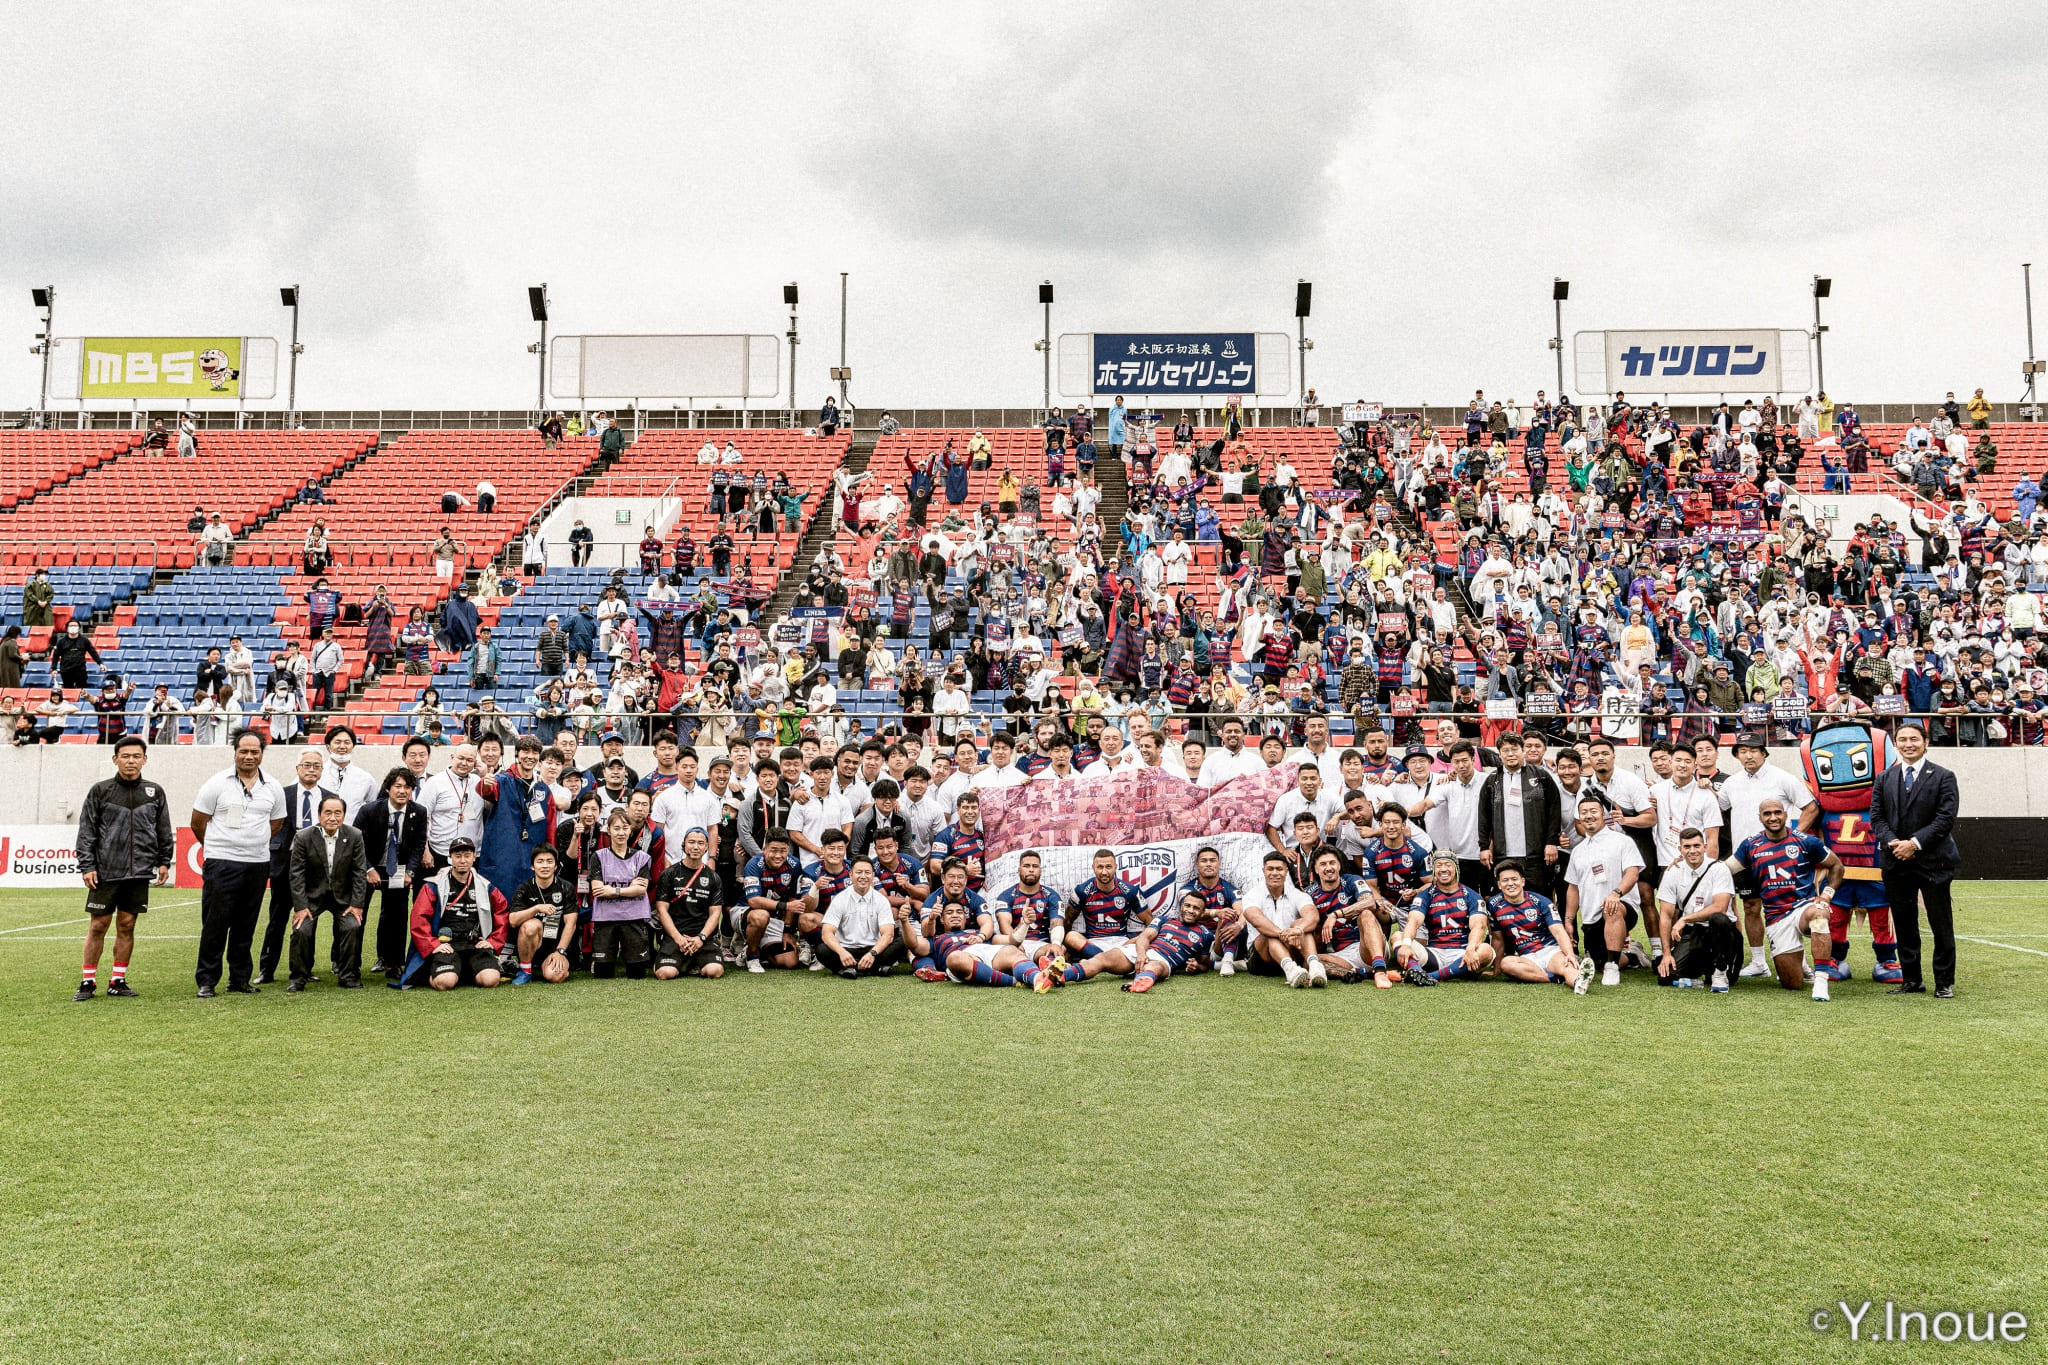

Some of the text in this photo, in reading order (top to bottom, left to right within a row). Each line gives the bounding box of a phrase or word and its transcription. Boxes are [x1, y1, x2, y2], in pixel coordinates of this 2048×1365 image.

[1128, 342, 1213, 356] 東大阪石切温泉
[1620, 345, 1767, 377] カツロン
[88, 350, 195, 385] MBS
[1096, 360, 1253, 387] ホテルセイリュウ
[1837, 815, 1866, 842] L
[1118, 853, 1172, 870] LINERS
